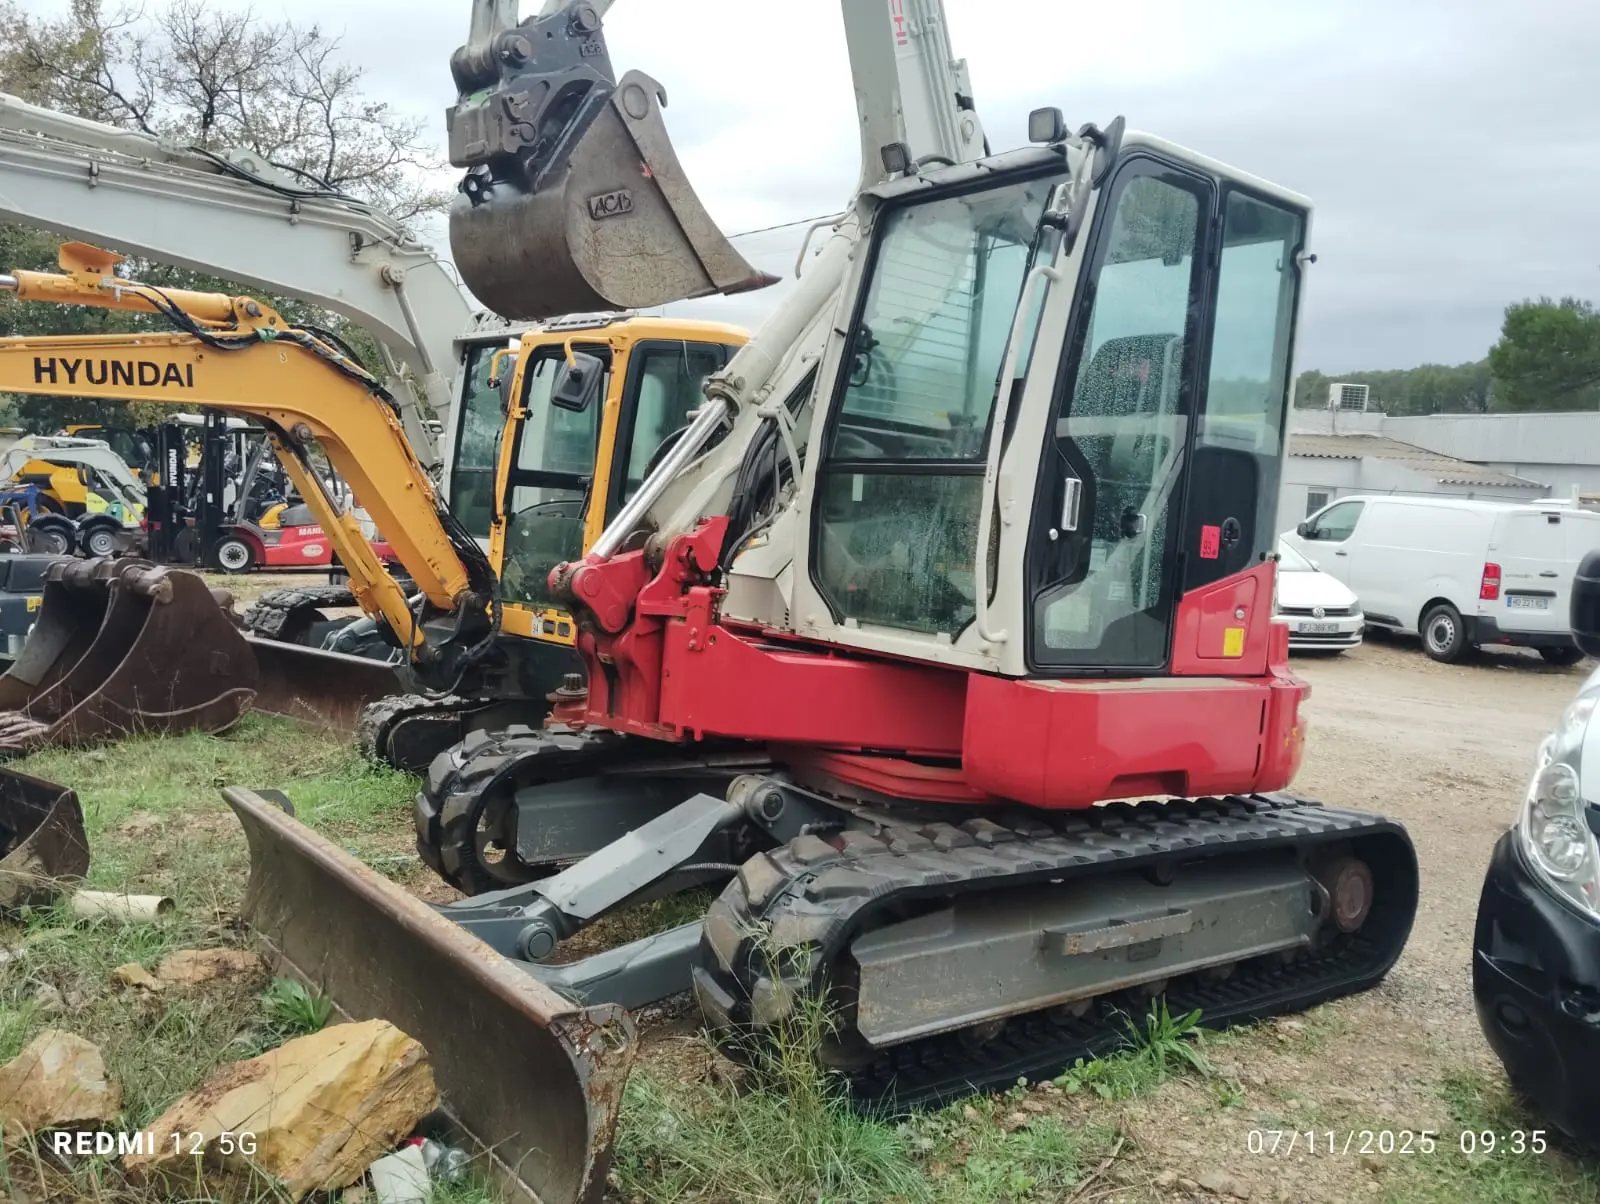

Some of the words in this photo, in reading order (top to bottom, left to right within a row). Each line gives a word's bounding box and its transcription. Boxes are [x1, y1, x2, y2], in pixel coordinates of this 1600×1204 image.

[594, 193, 632, 217] ACB
[34, 357, 194, 388] HYUNDAI
[169, 449, 177, 486] HYUNDAI
